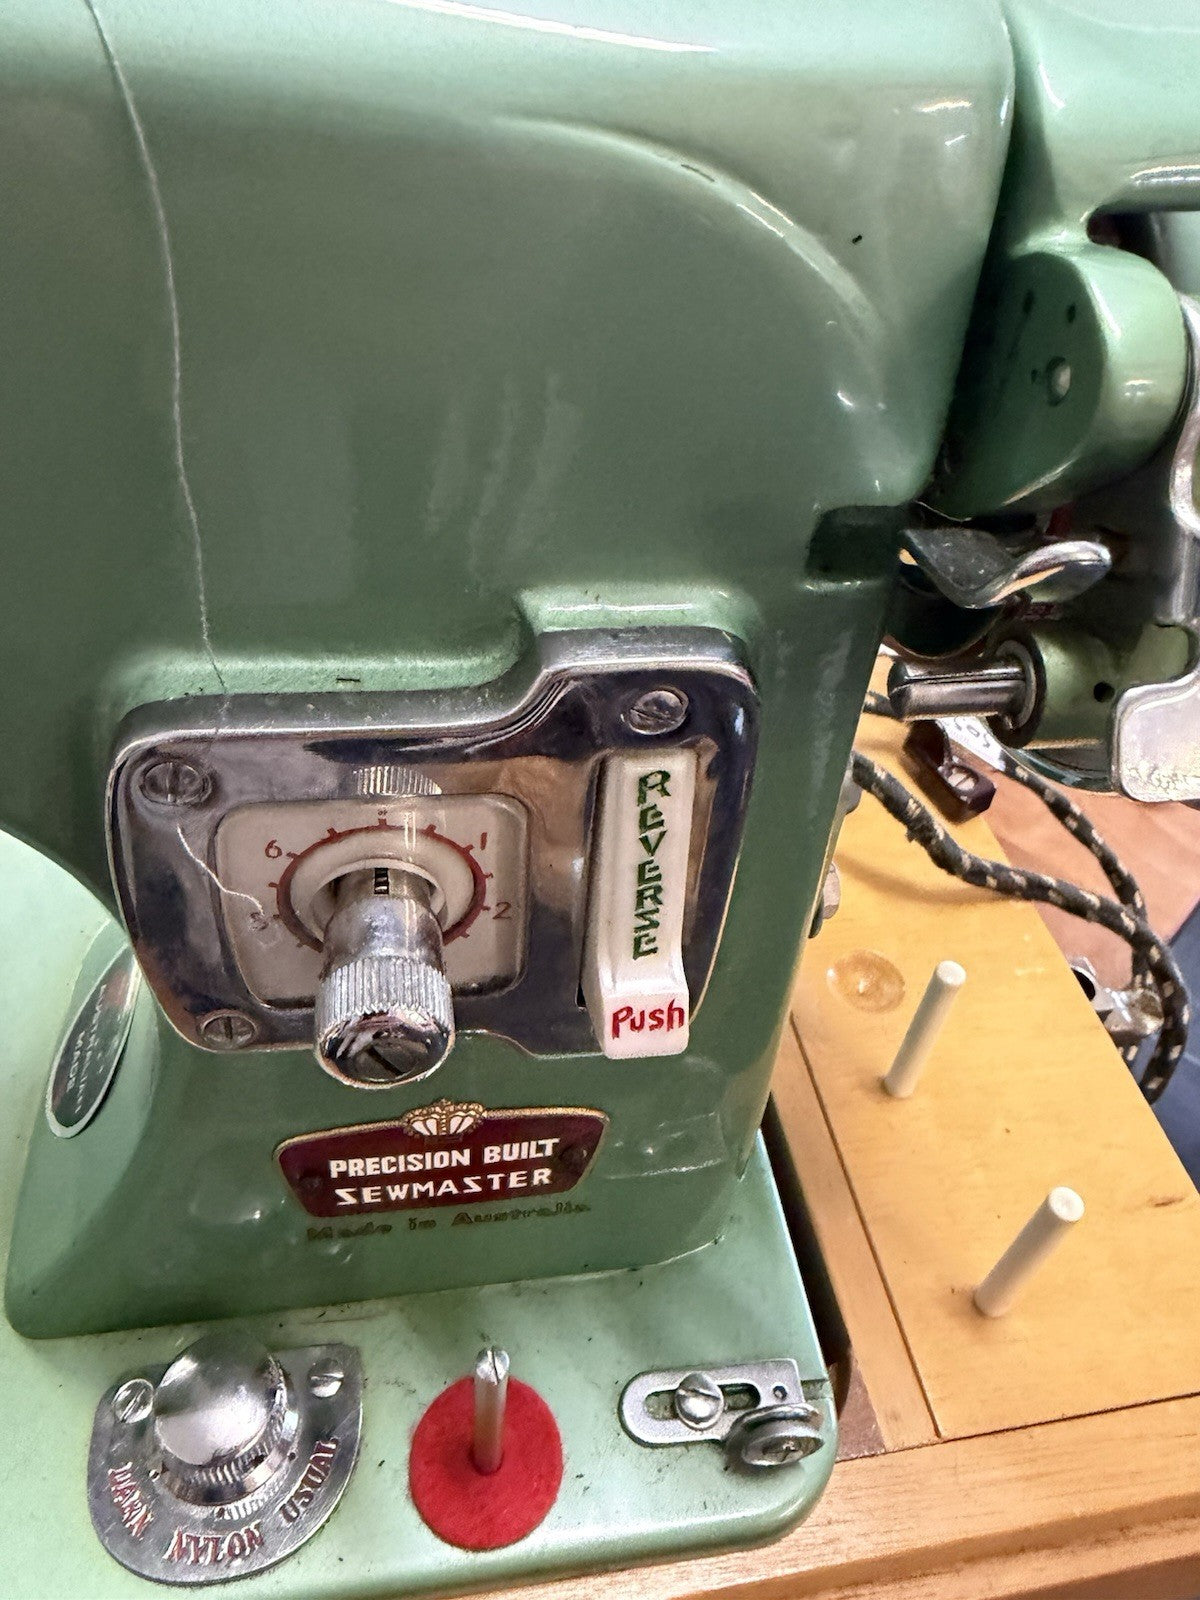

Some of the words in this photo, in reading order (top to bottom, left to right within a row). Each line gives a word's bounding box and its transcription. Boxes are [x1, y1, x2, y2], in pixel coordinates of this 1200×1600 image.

[264, 839, 283, 859] 6
[480, 831, 488, 850] 1
[634, 770, 672, 961] REVERSE
[492, 901, 512, 920] 2
[611, 999, 685, 1039] Push
[328, 1148, 471, 1179] PRECISION
[482, 1137, 560, 1165] BUILT
[334, 1168, 553, 1206] SEWMASTER
[278, 1436, 340, 1526] USUAL
[162, 1520, 265, 1566] NYLON
